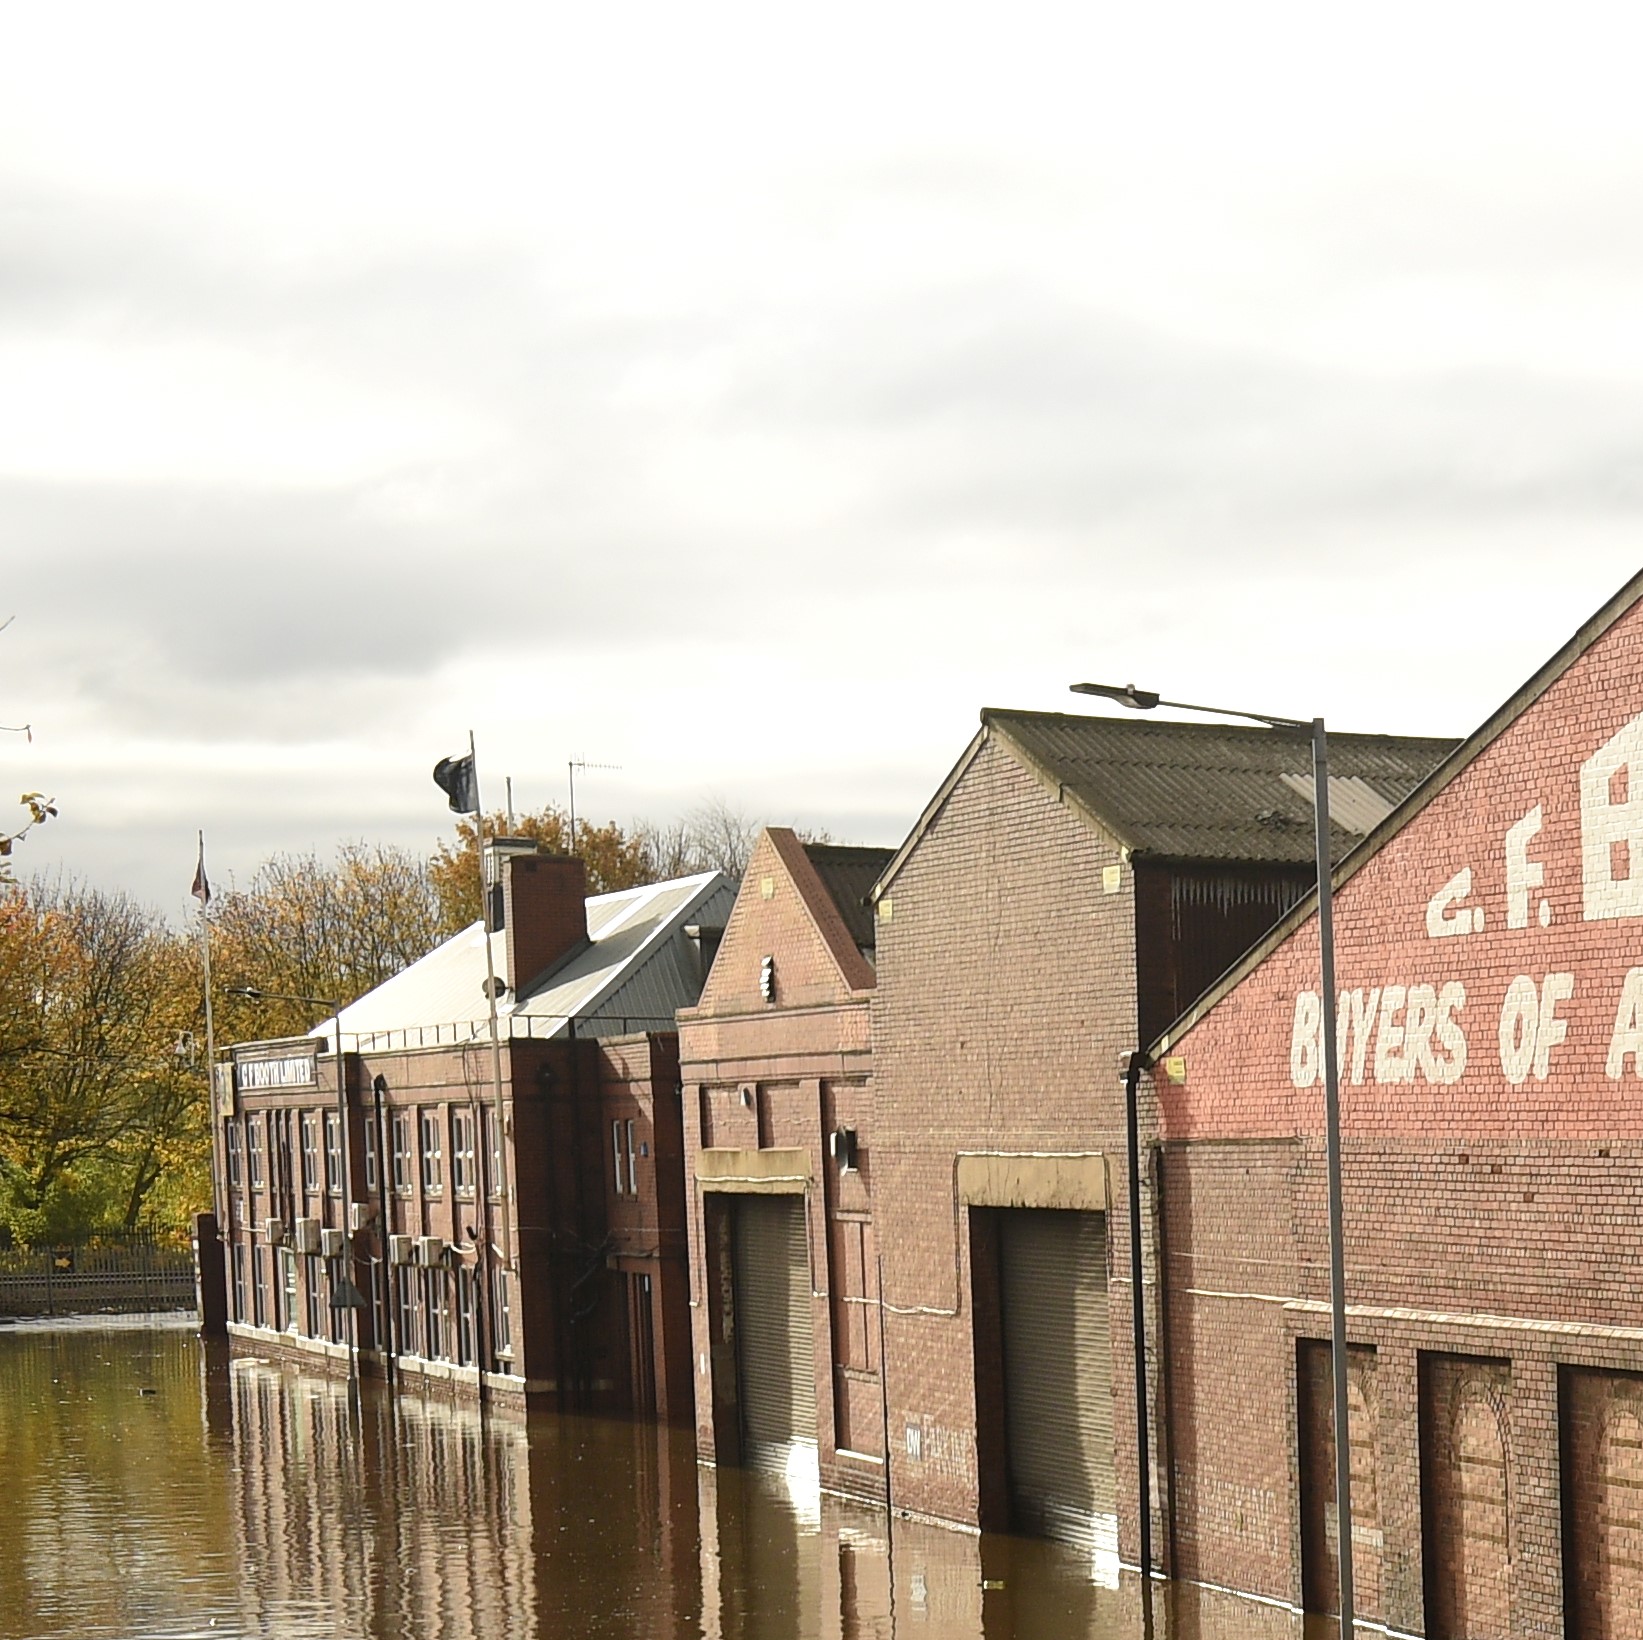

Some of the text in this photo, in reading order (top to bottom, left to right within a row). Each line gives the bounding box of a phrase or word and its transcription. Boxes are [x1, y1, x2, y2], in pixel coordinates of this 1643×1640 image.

[1290, 980, 1468, 1088] BUYERS
[1500, 972, 1575, 1085] OF
[254, 1060, 279, 1086] BOOTH
[280, 1058, 311, 1084] LIMITED
